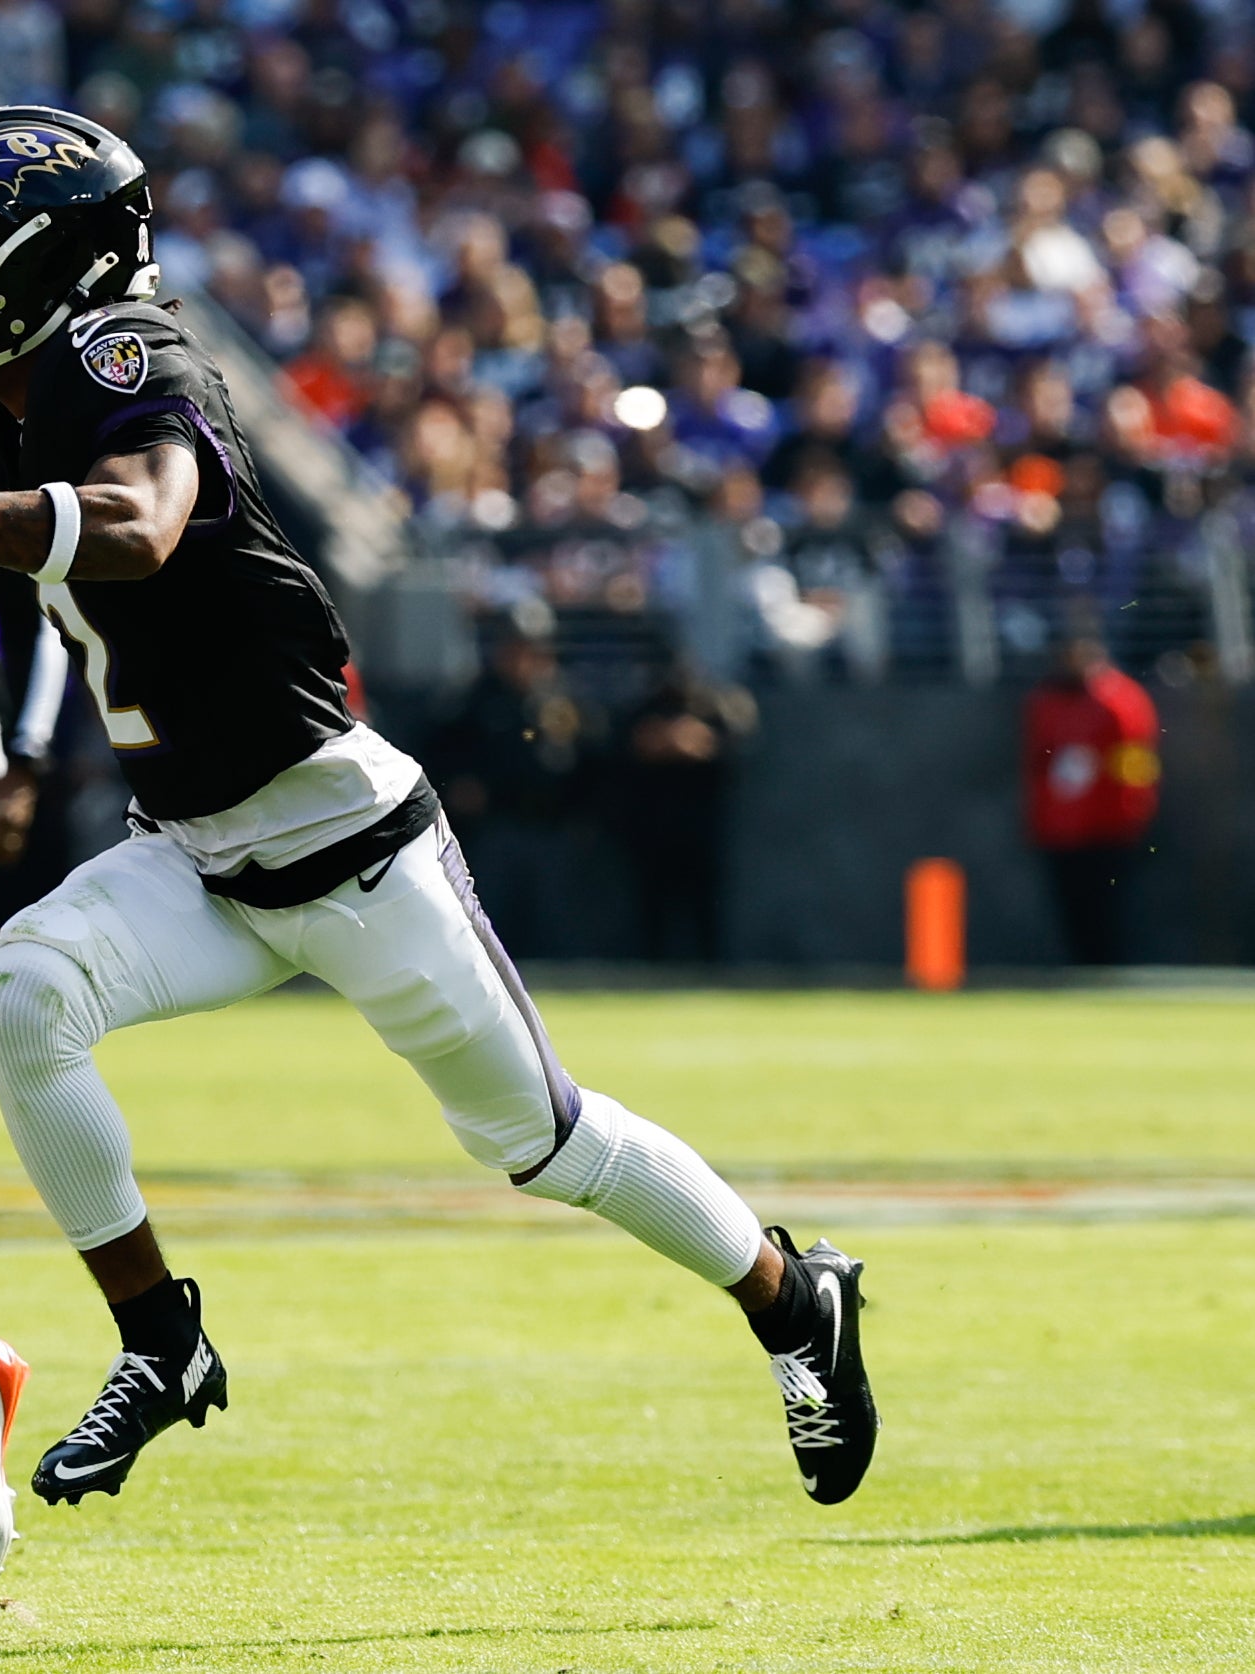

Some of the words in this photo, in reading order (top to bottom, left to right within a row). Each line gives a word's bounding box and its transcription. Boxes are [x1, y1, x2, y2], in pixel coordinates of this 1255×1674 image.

[87, 336, 132, 358] RAVENS
[36, 579, 161, 749] 2
[181, 1331, 213, 1405] NIKE
